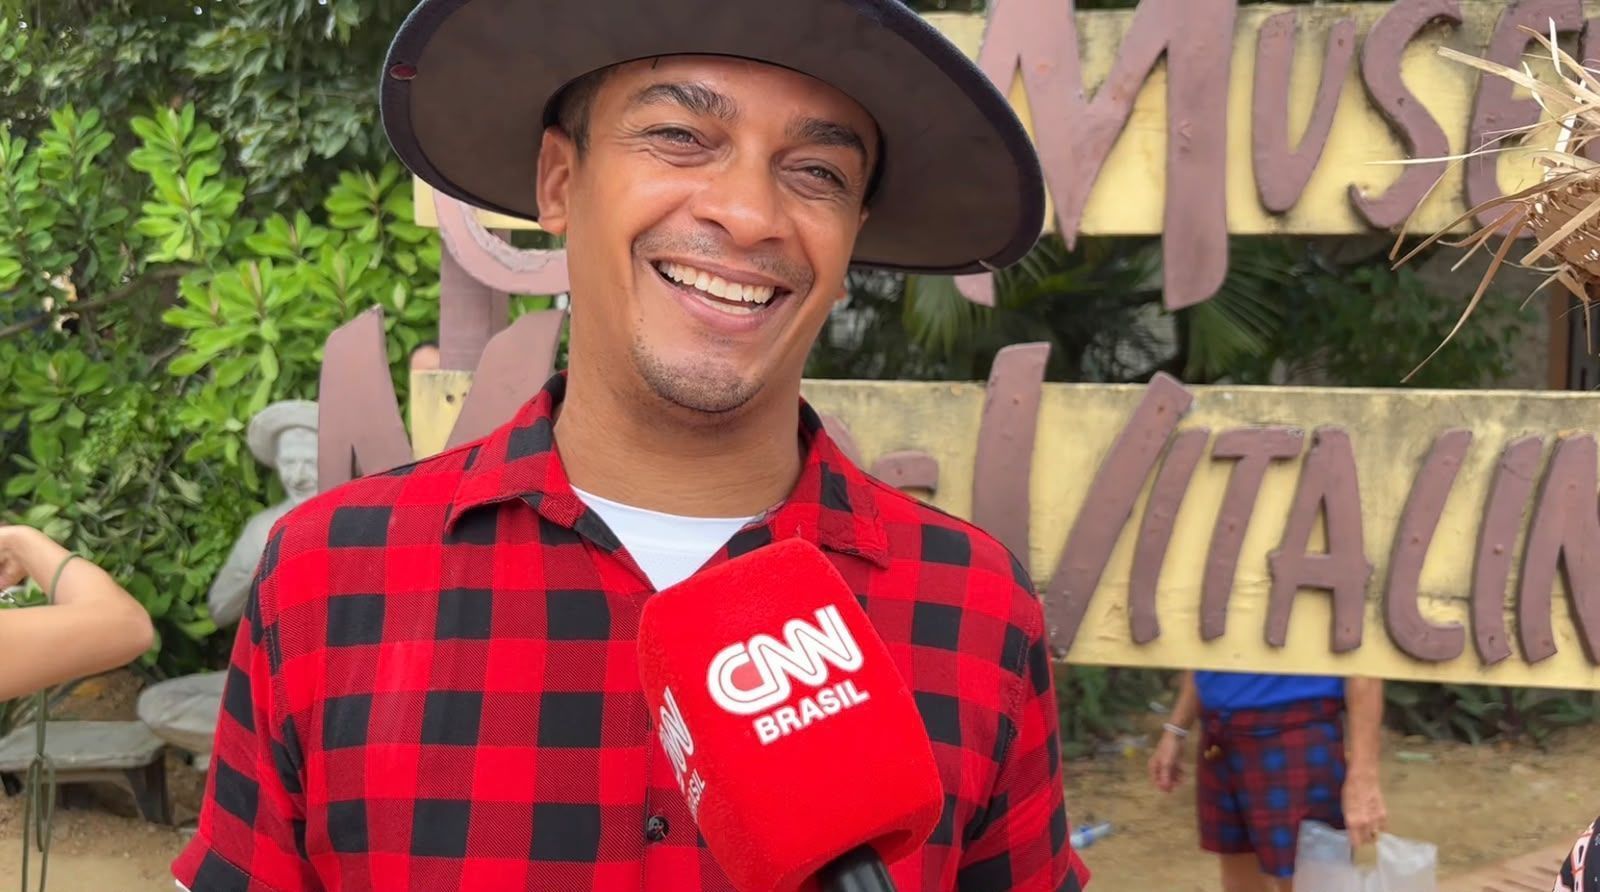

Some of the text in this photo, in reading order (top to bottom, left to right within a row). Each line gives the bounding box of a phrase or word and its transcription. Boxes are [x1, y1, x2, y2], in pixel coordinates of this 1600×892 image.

[954, 0, 1600, 310] MUSE
[707, 604, 864, 715] CNN
[753, 680, 870, 745] BRASIL
